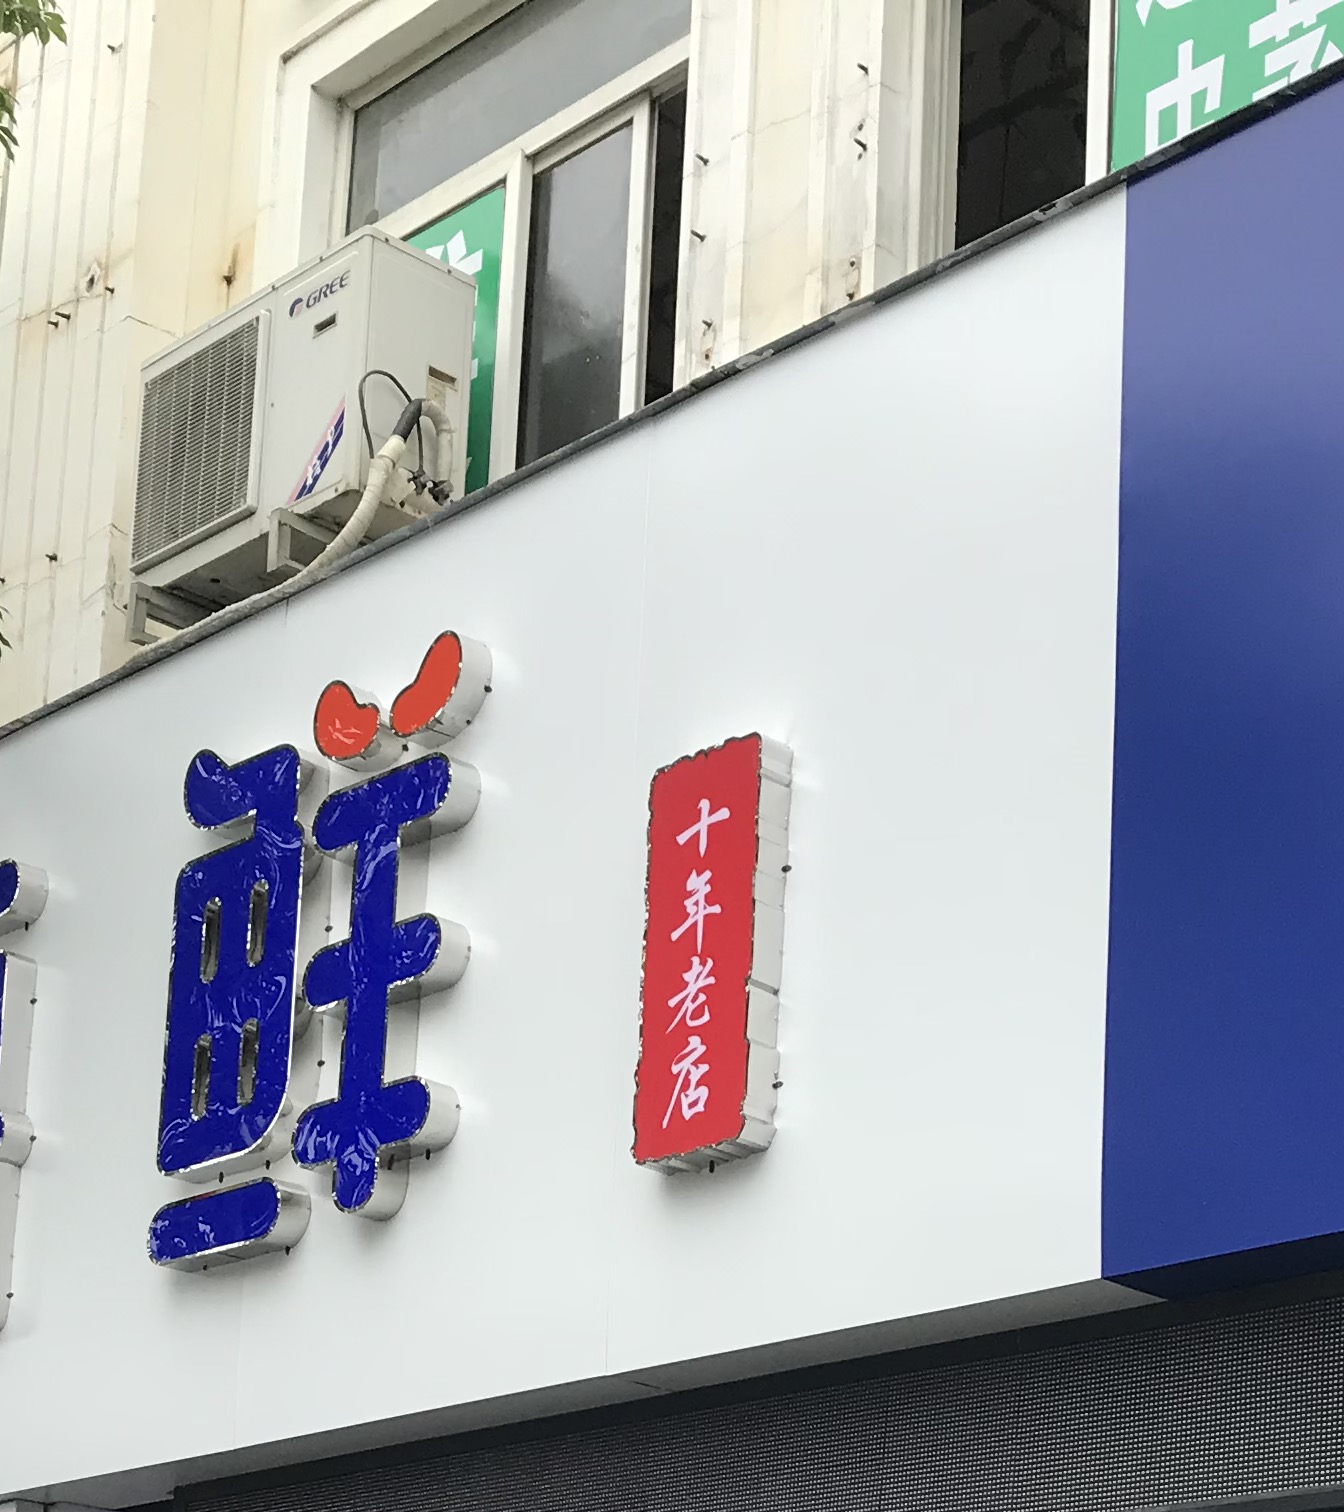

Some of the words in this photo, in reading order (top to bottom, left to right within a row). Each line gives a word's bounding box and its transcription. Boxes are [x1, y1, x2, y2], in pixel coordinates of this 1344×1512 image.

[306, 269, 352, 310] GREE
[659, 794, 733, 1133] 十年老店
